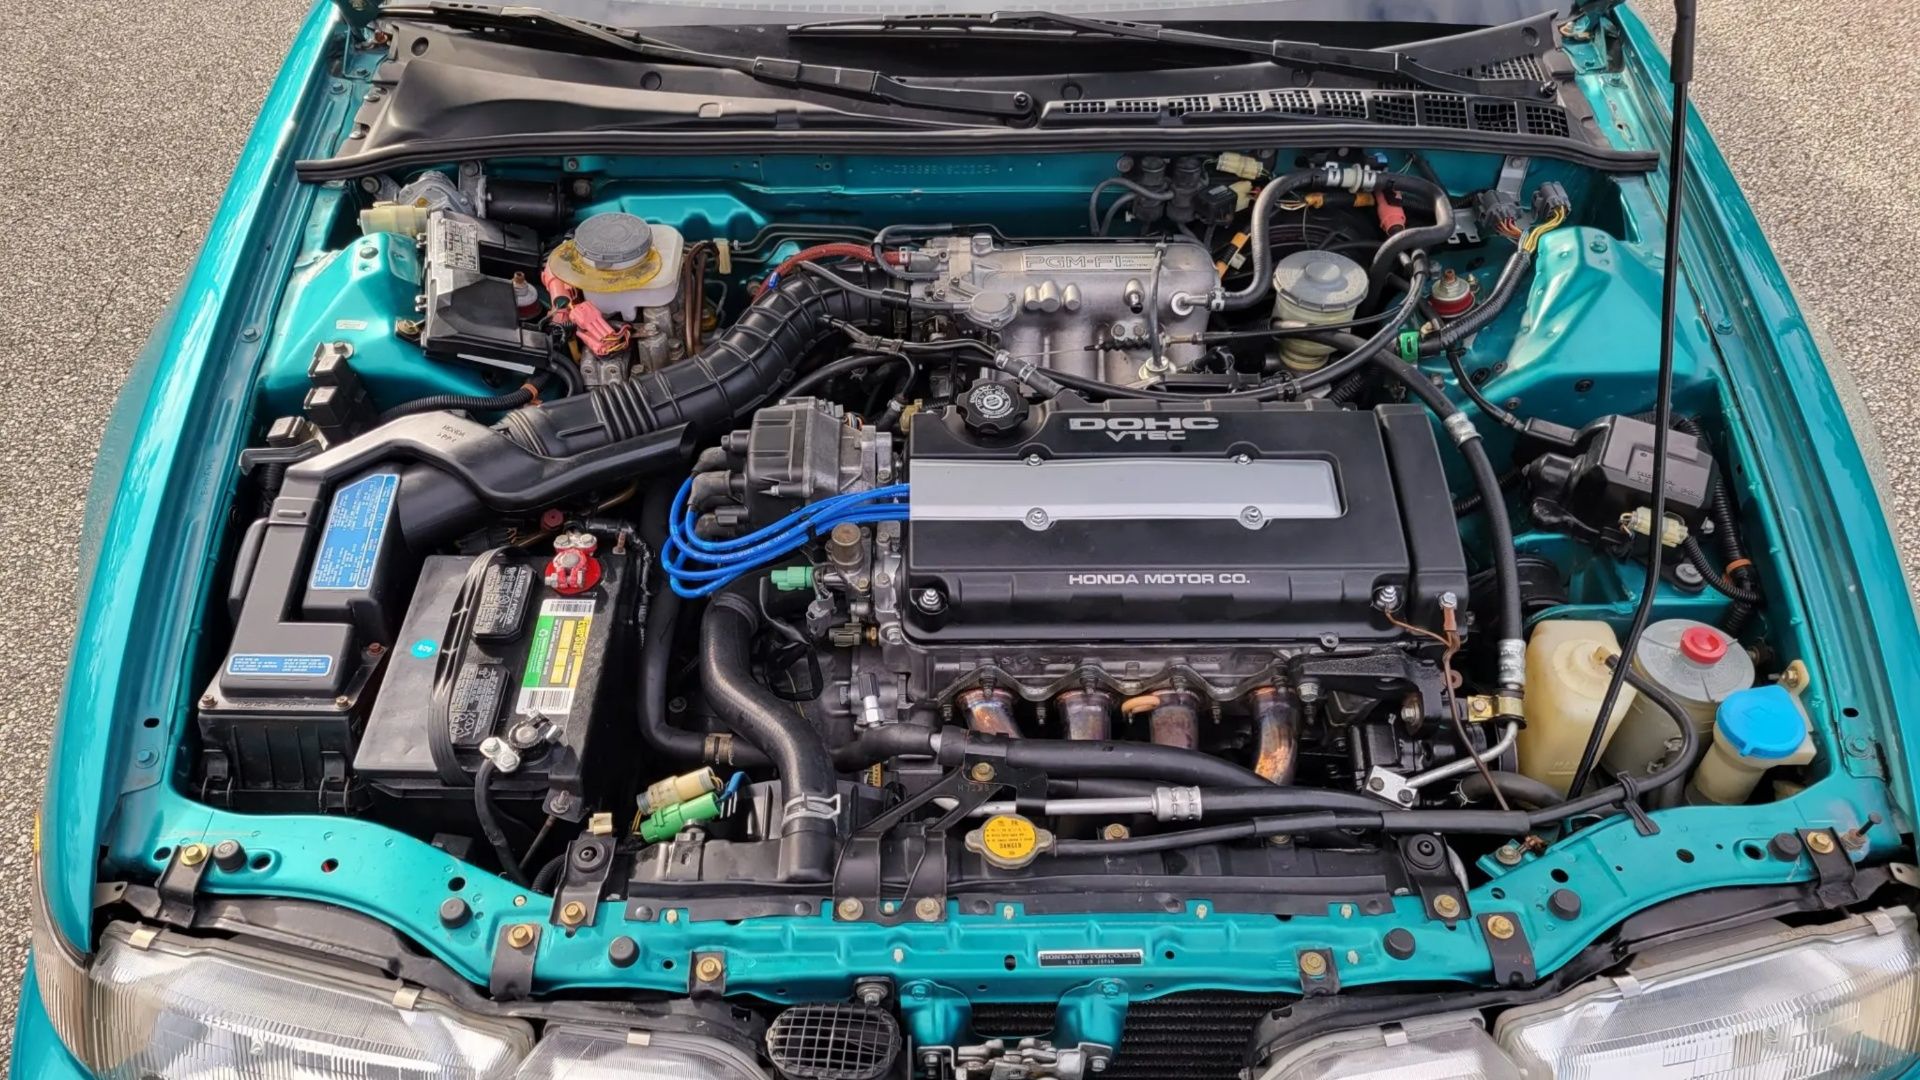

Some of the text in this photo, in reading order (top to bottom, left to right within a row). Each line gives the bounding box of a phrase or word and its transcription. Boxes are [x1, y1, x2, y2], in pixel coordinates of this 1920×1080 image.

[1025, 255, 1122, 268] PGM-FI
[1069, 417, 1219, 430] DOHC
[1105, 430, 1187, 442] VTEC
[1069, 573, 1251, 585] HONDA MOTOR CO.
[1074, 952, 1108, 960] MOTOR
